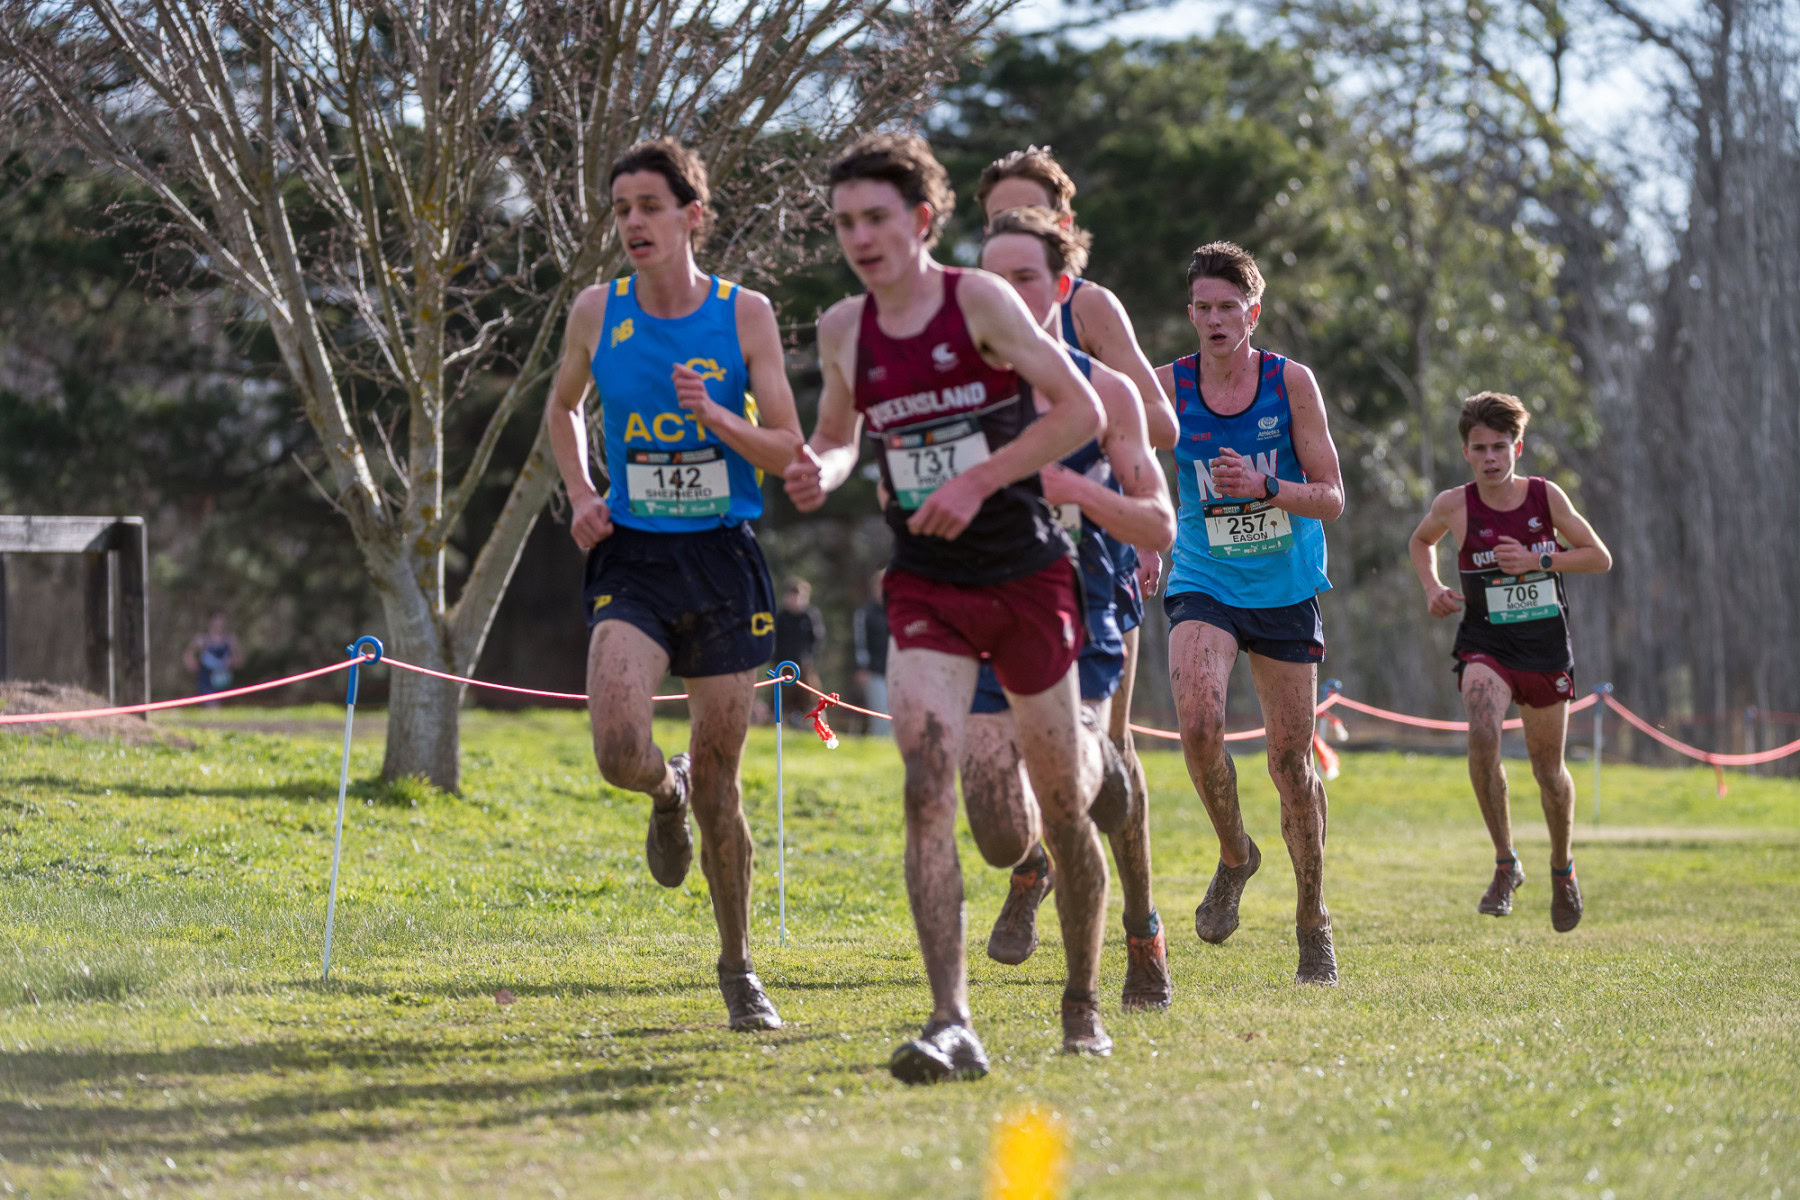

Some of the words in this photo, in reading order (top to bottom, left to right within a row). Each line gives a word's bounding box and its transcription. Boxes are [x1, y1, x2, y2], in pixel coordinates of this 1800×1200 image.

[624, 412, 706, 442] ACT
[908, 445, 956, 476] 737
[653, 466, 702, 489] 142
[1193, 448, 1279, 501] NW
[1227, 513, 1266, 535] 257
[1232, 531, 1268, 543] EASON
[1503, 584, 1538, 603] 706
[1507, 600, 1538, 609] MOORE
